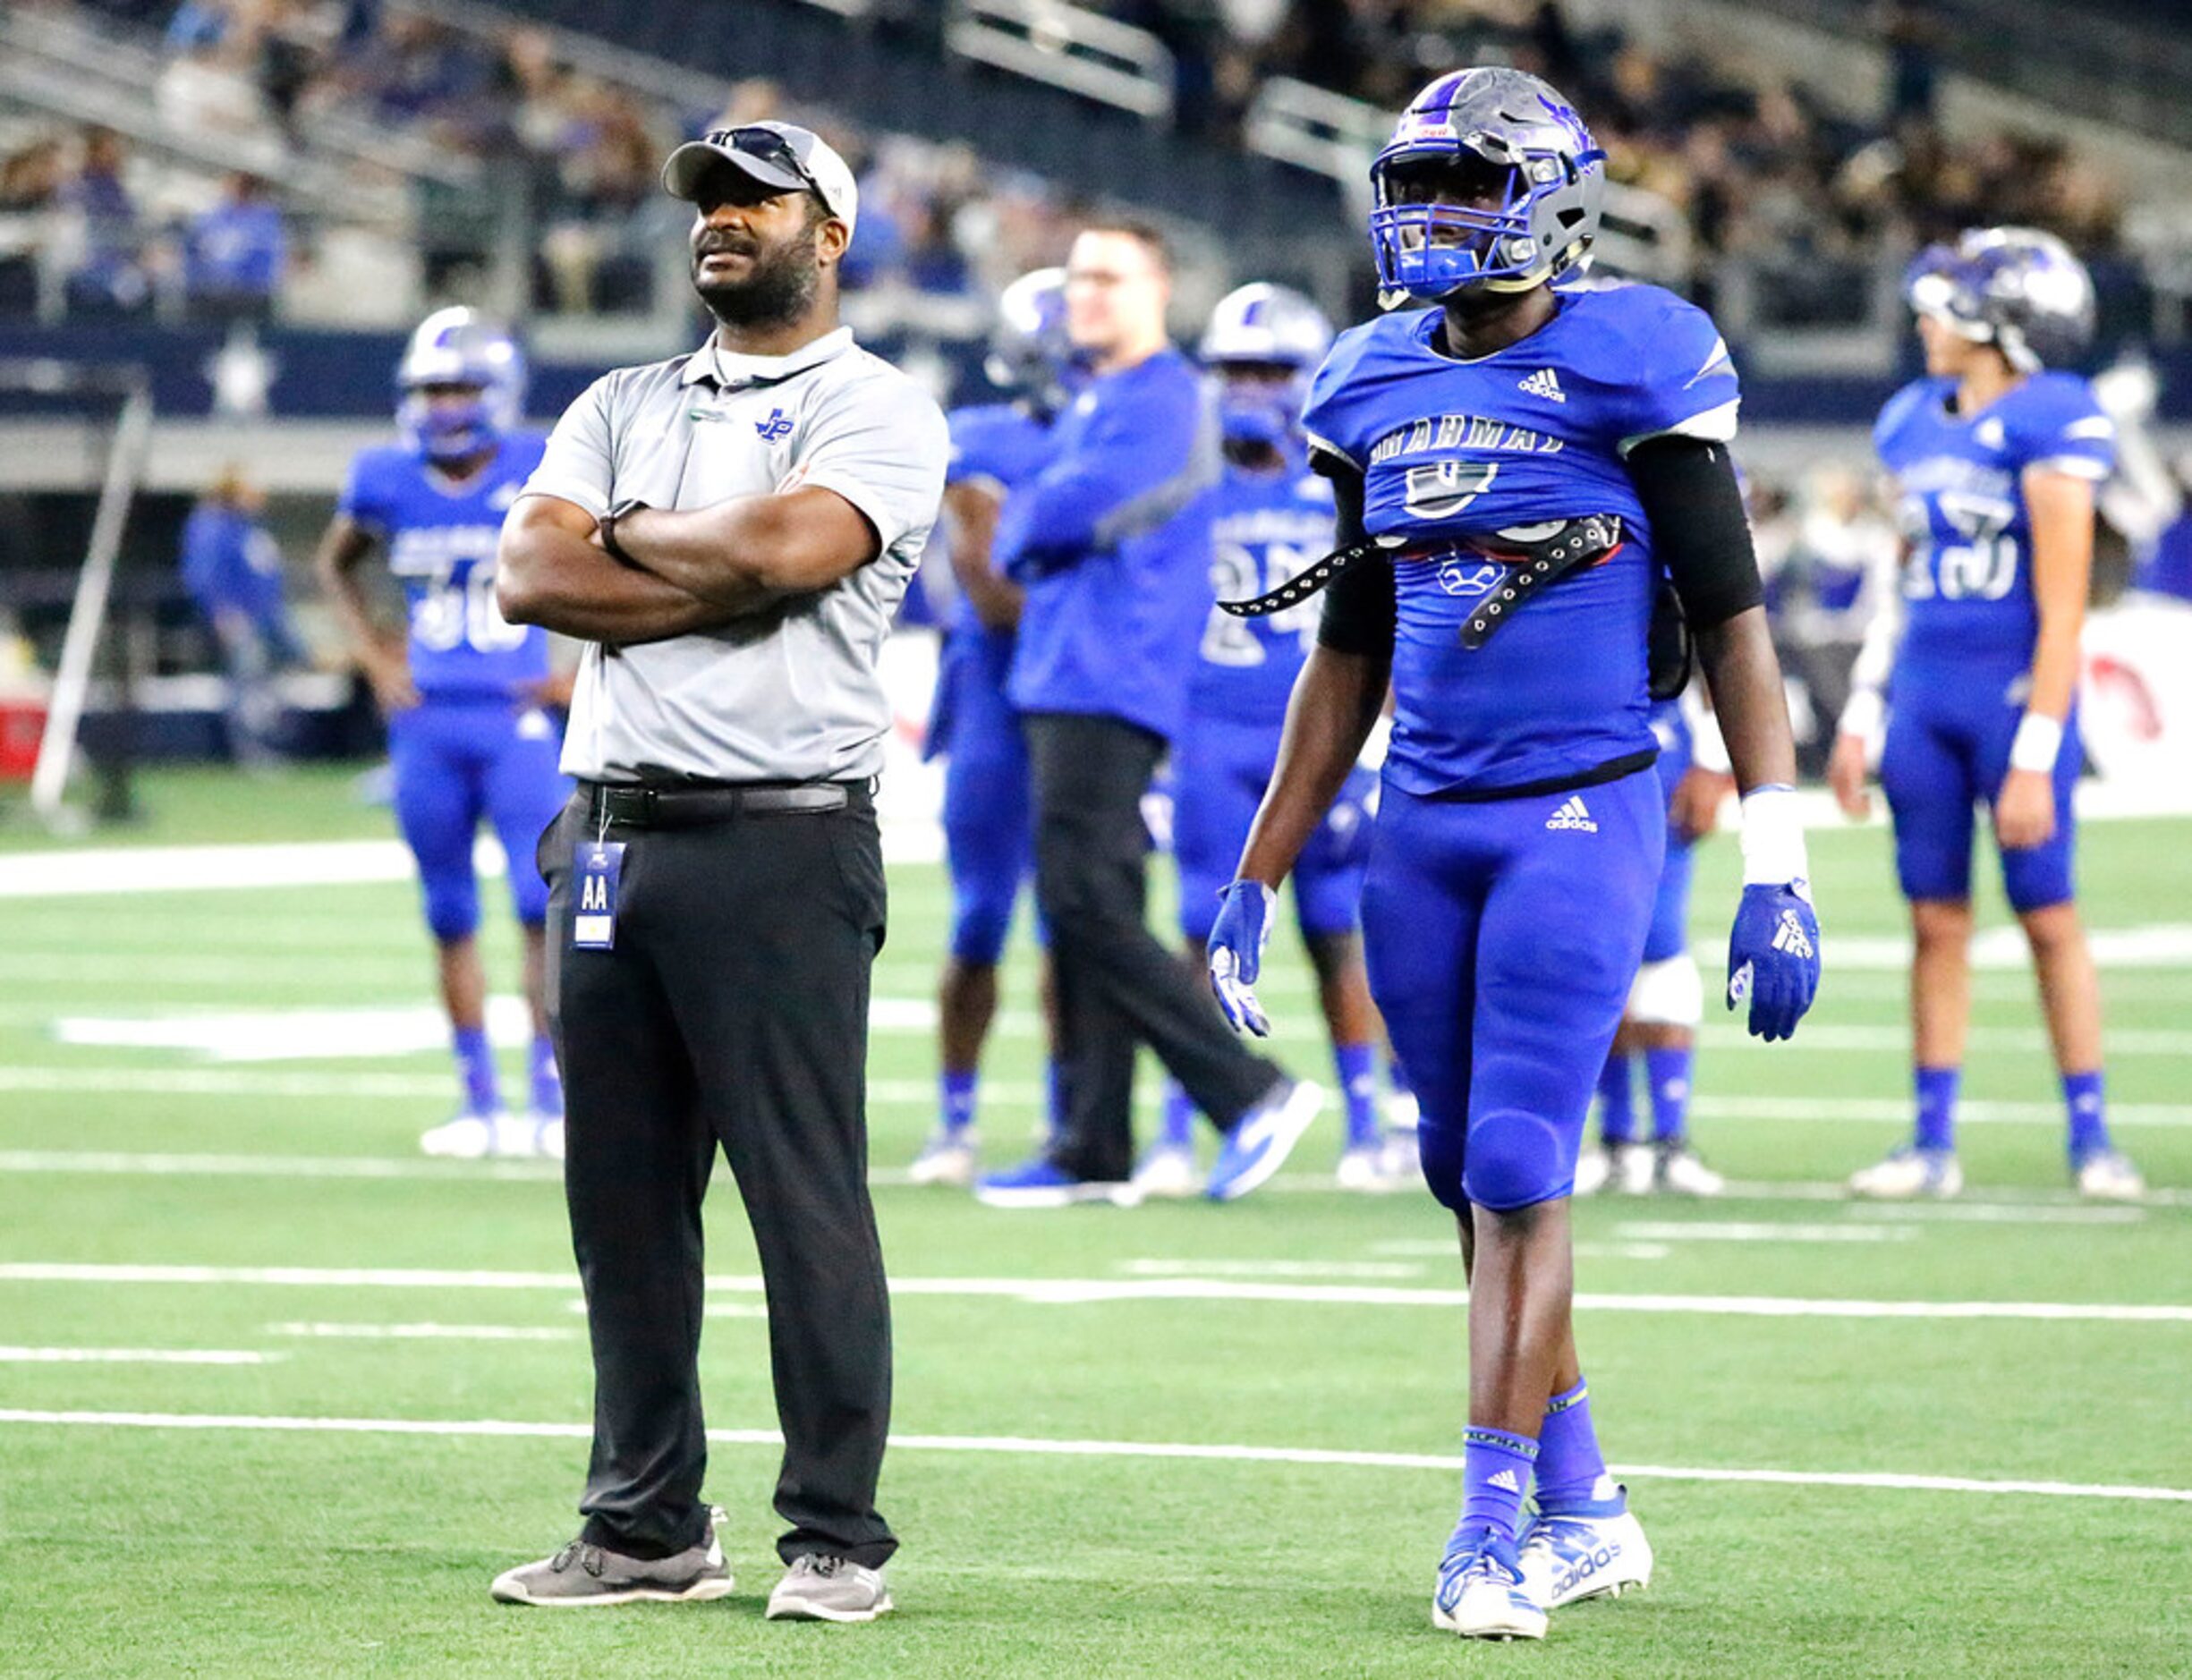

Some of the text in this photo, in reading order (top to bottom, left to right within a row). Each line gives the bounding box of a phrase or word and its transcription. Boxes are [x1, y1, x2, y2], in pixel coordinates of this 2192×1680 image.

[1544, 818, 1599, 834] adidas
[581, 874, 607, 911] AA
[1551, 1540, 1621, 1601] adidas
